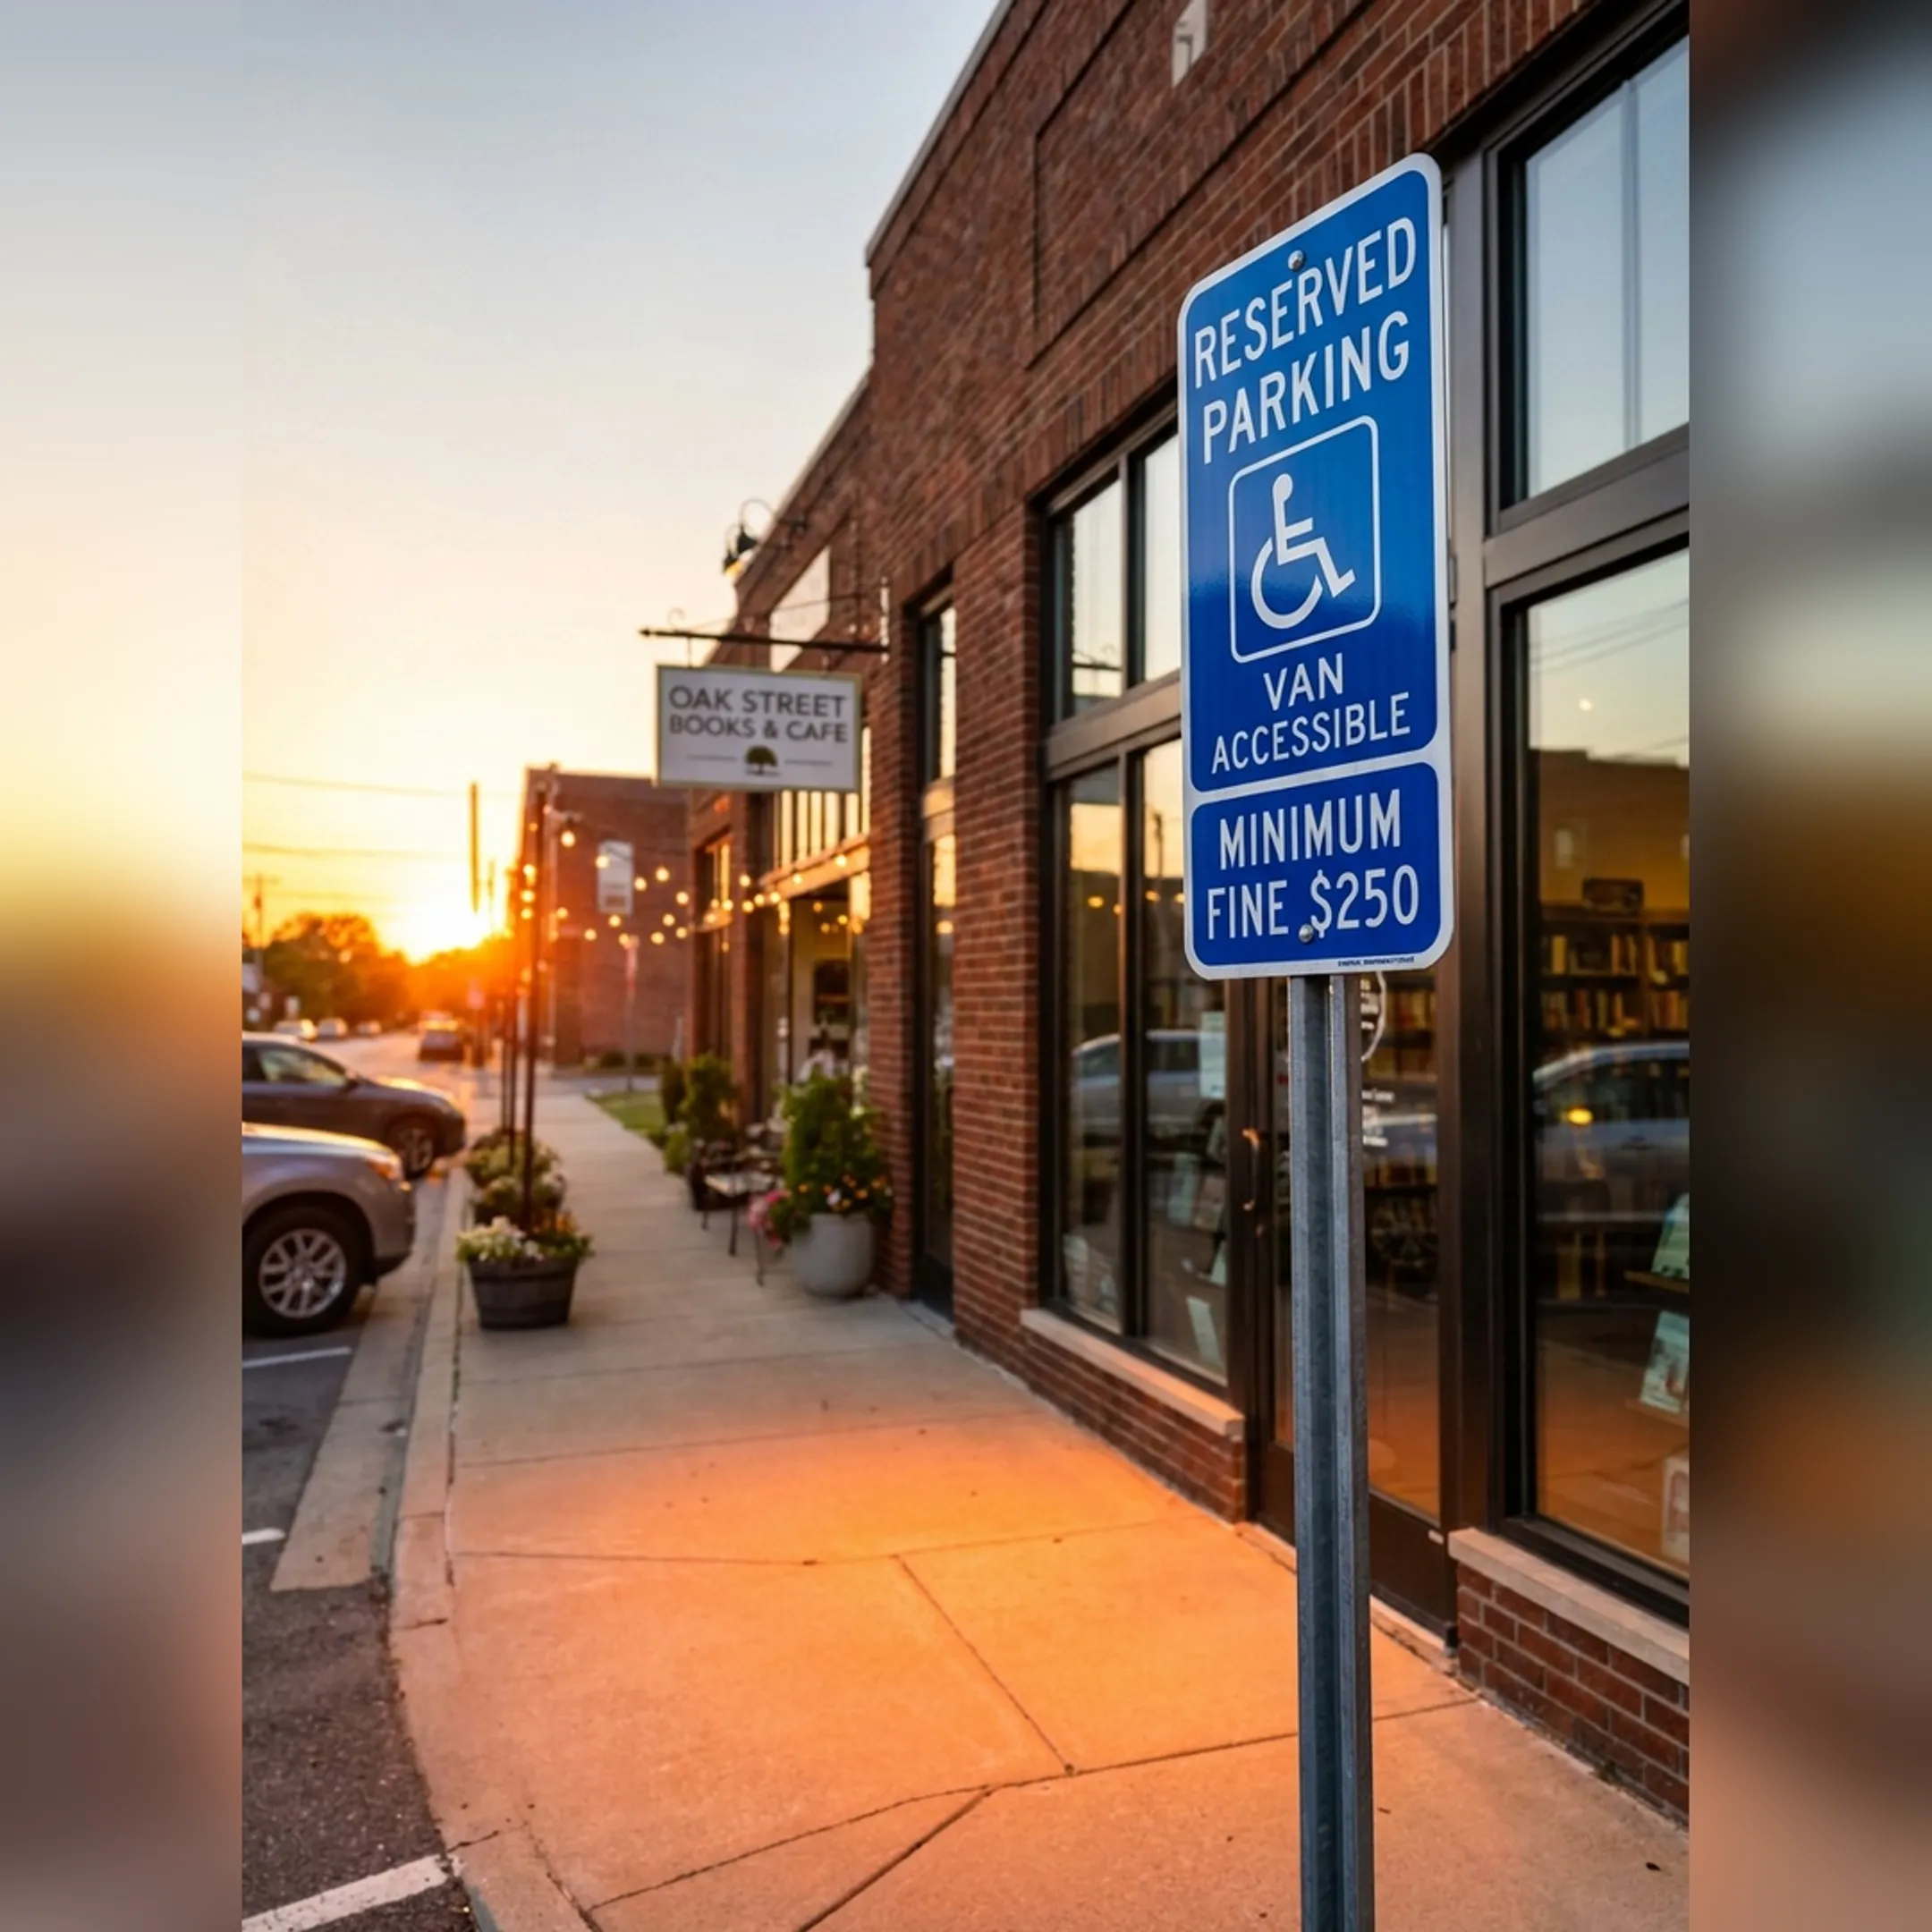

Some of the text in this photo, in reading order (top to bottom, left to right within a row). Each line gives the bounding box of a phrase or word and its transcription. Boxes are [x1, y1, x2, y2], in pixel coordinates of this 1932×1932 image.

[1195, 217, 1416, 388] RESERVED
[1203, 310, 1409, 464] PARKING
[669, 685, 847, 718] OAK STREET
[1263, 653, 1343, 711] VAN
[669, 715, 848, 743] BOOKS & CAFE
[1211, 691, 1411, 774] ACCESSIBLE
[1219, 789, 1401, 870] MINIMUM
[1208, 864, 1419, 940] FINE $250
